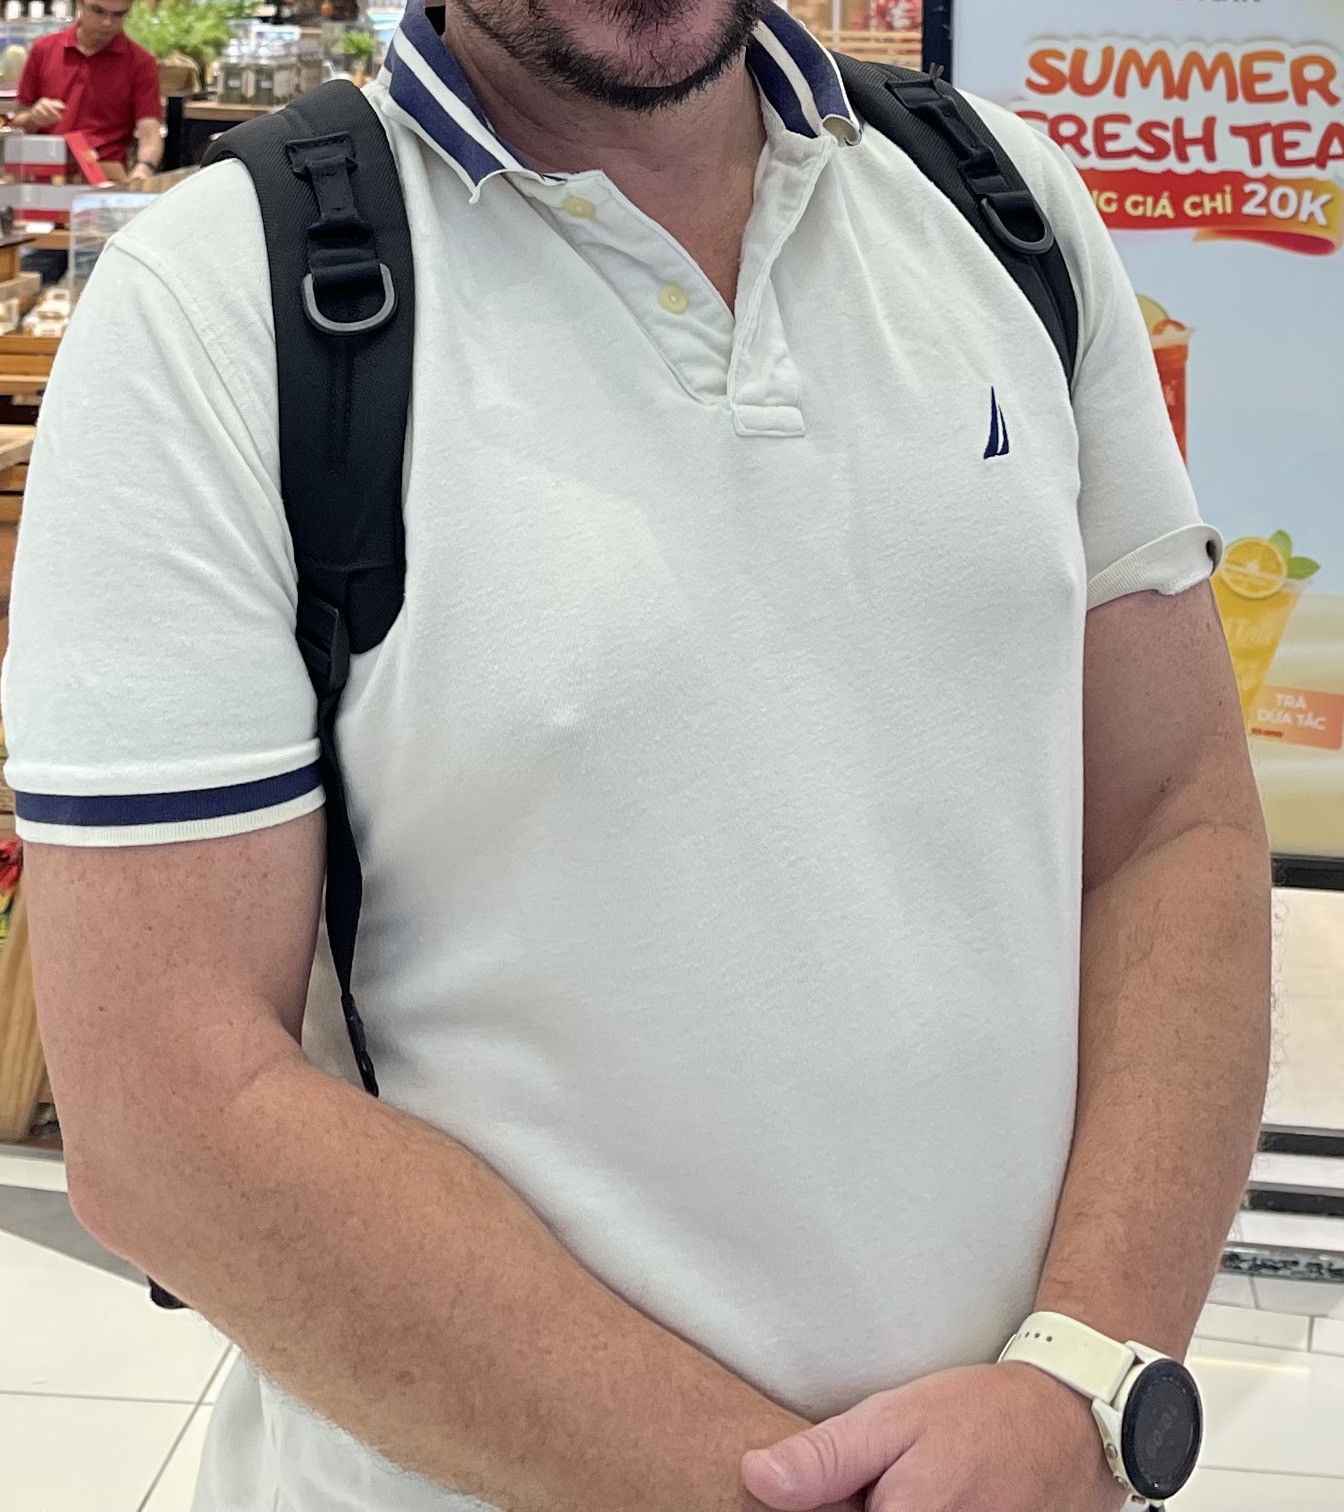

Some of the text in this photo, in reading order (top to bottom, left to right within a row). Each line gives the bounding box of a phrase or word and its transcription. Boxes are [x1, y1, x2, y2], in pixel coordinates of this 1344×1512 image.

[1025, 46, 1342, 106] SUMMER
[1124, 189, 1175, 220] GIÁ
[1183, 185, 1233, 218] CHỈ
[1241, 184, 1334, 226] 20K
